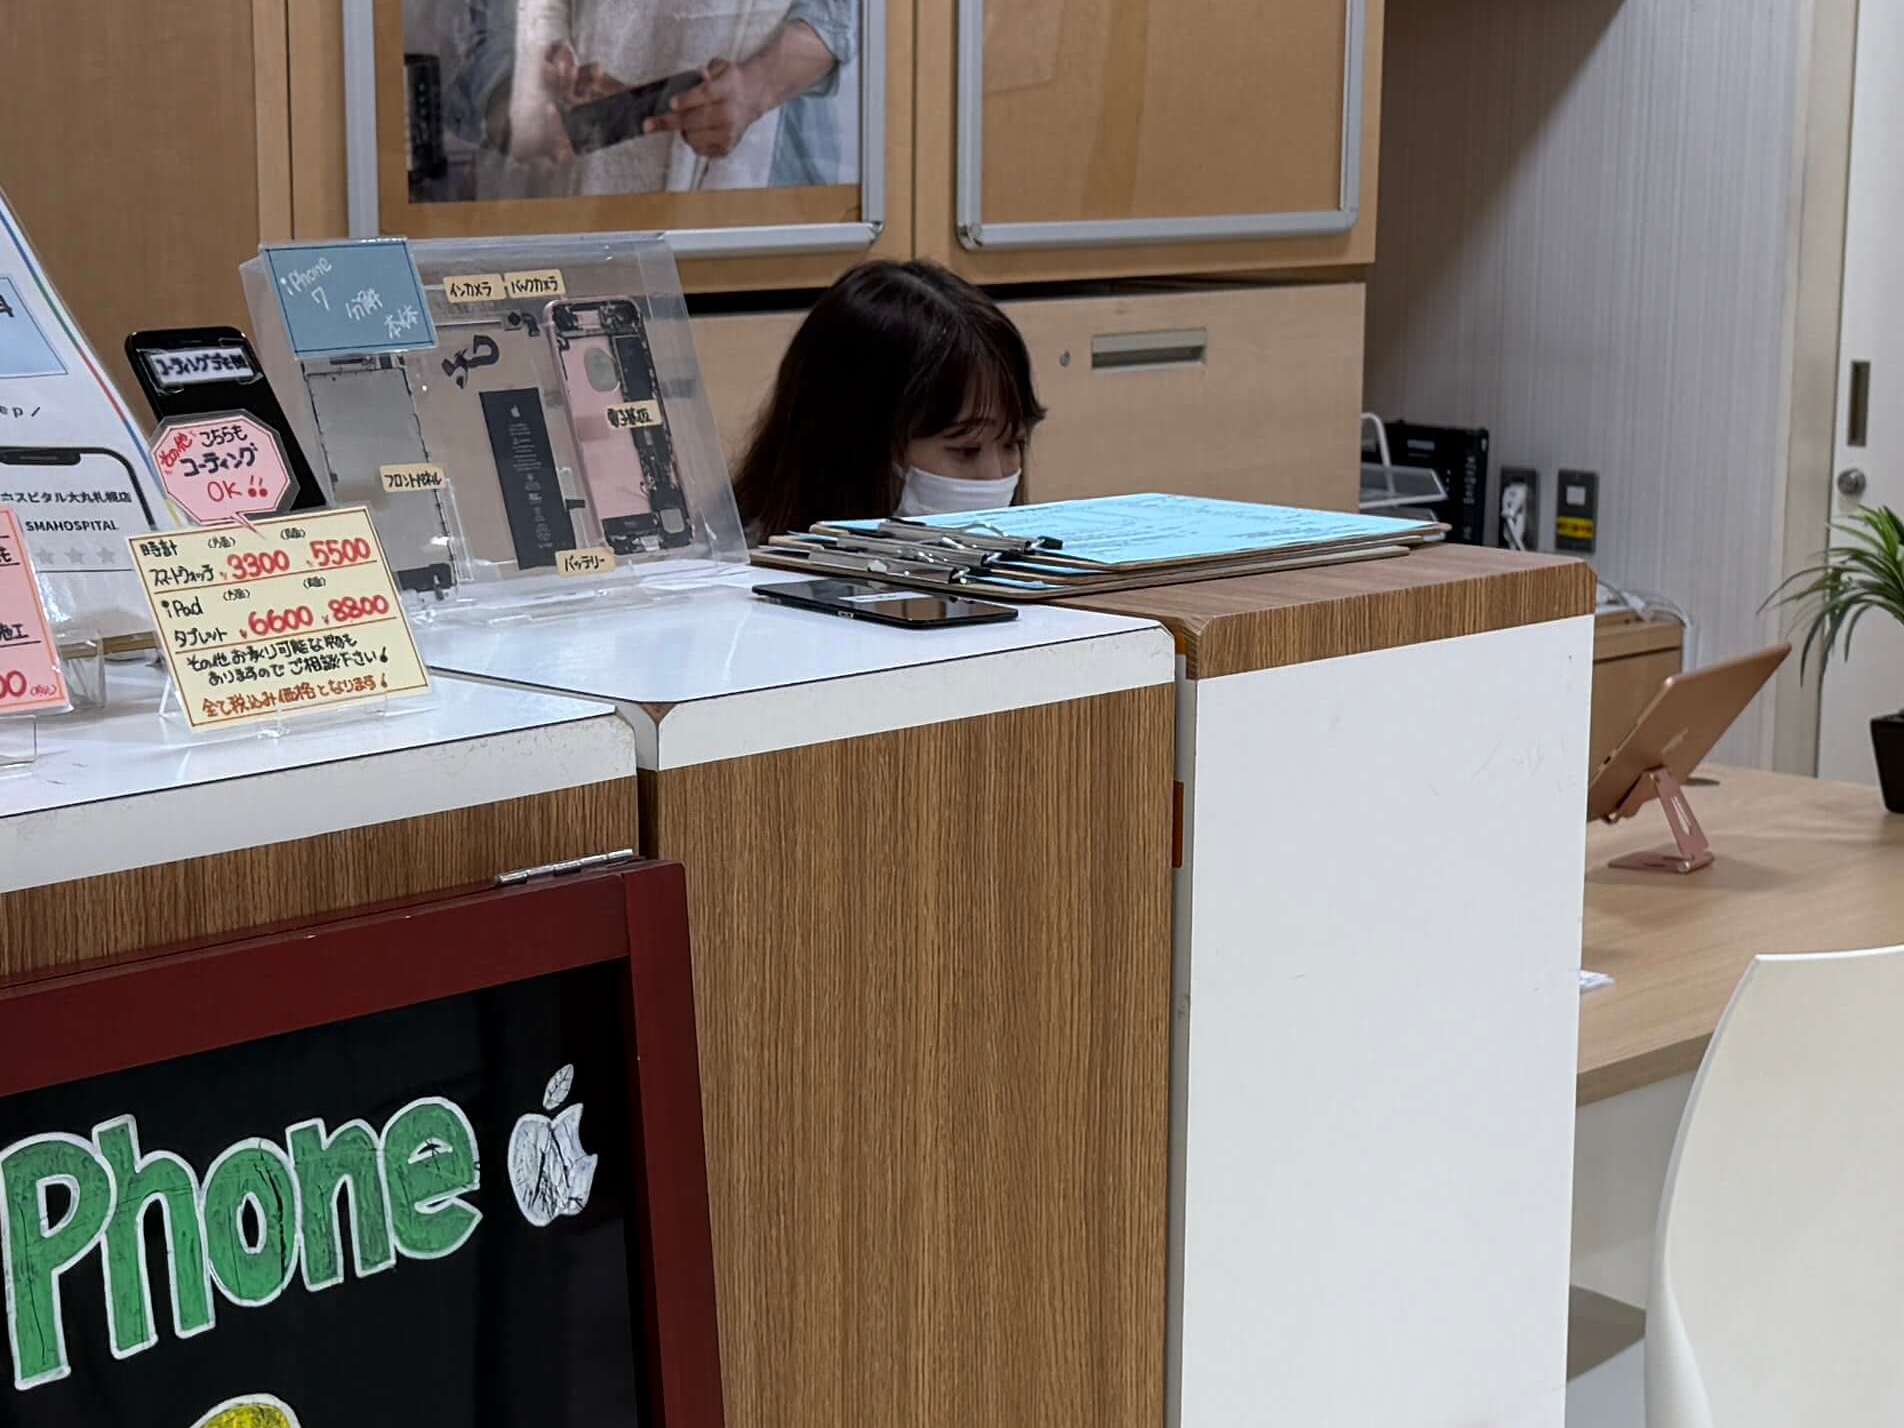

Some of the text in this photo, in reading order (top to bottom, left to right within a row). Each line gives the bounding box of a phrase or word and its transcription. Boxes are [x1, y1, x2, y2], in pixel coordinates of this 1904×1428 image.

[280, 257, 333, 296] iPhone
[311, 286, 330, 311] 7
[449, 281, 492, 298] インカメラ
[179, 442, 259, 477] コーティング
[25, 520, 118, 533] SMAHOSPITAL
[139, 540, 179, 559] 時計
[161, 596, 204, 620] iPad
[174, 628, 228, 648] タブレット
